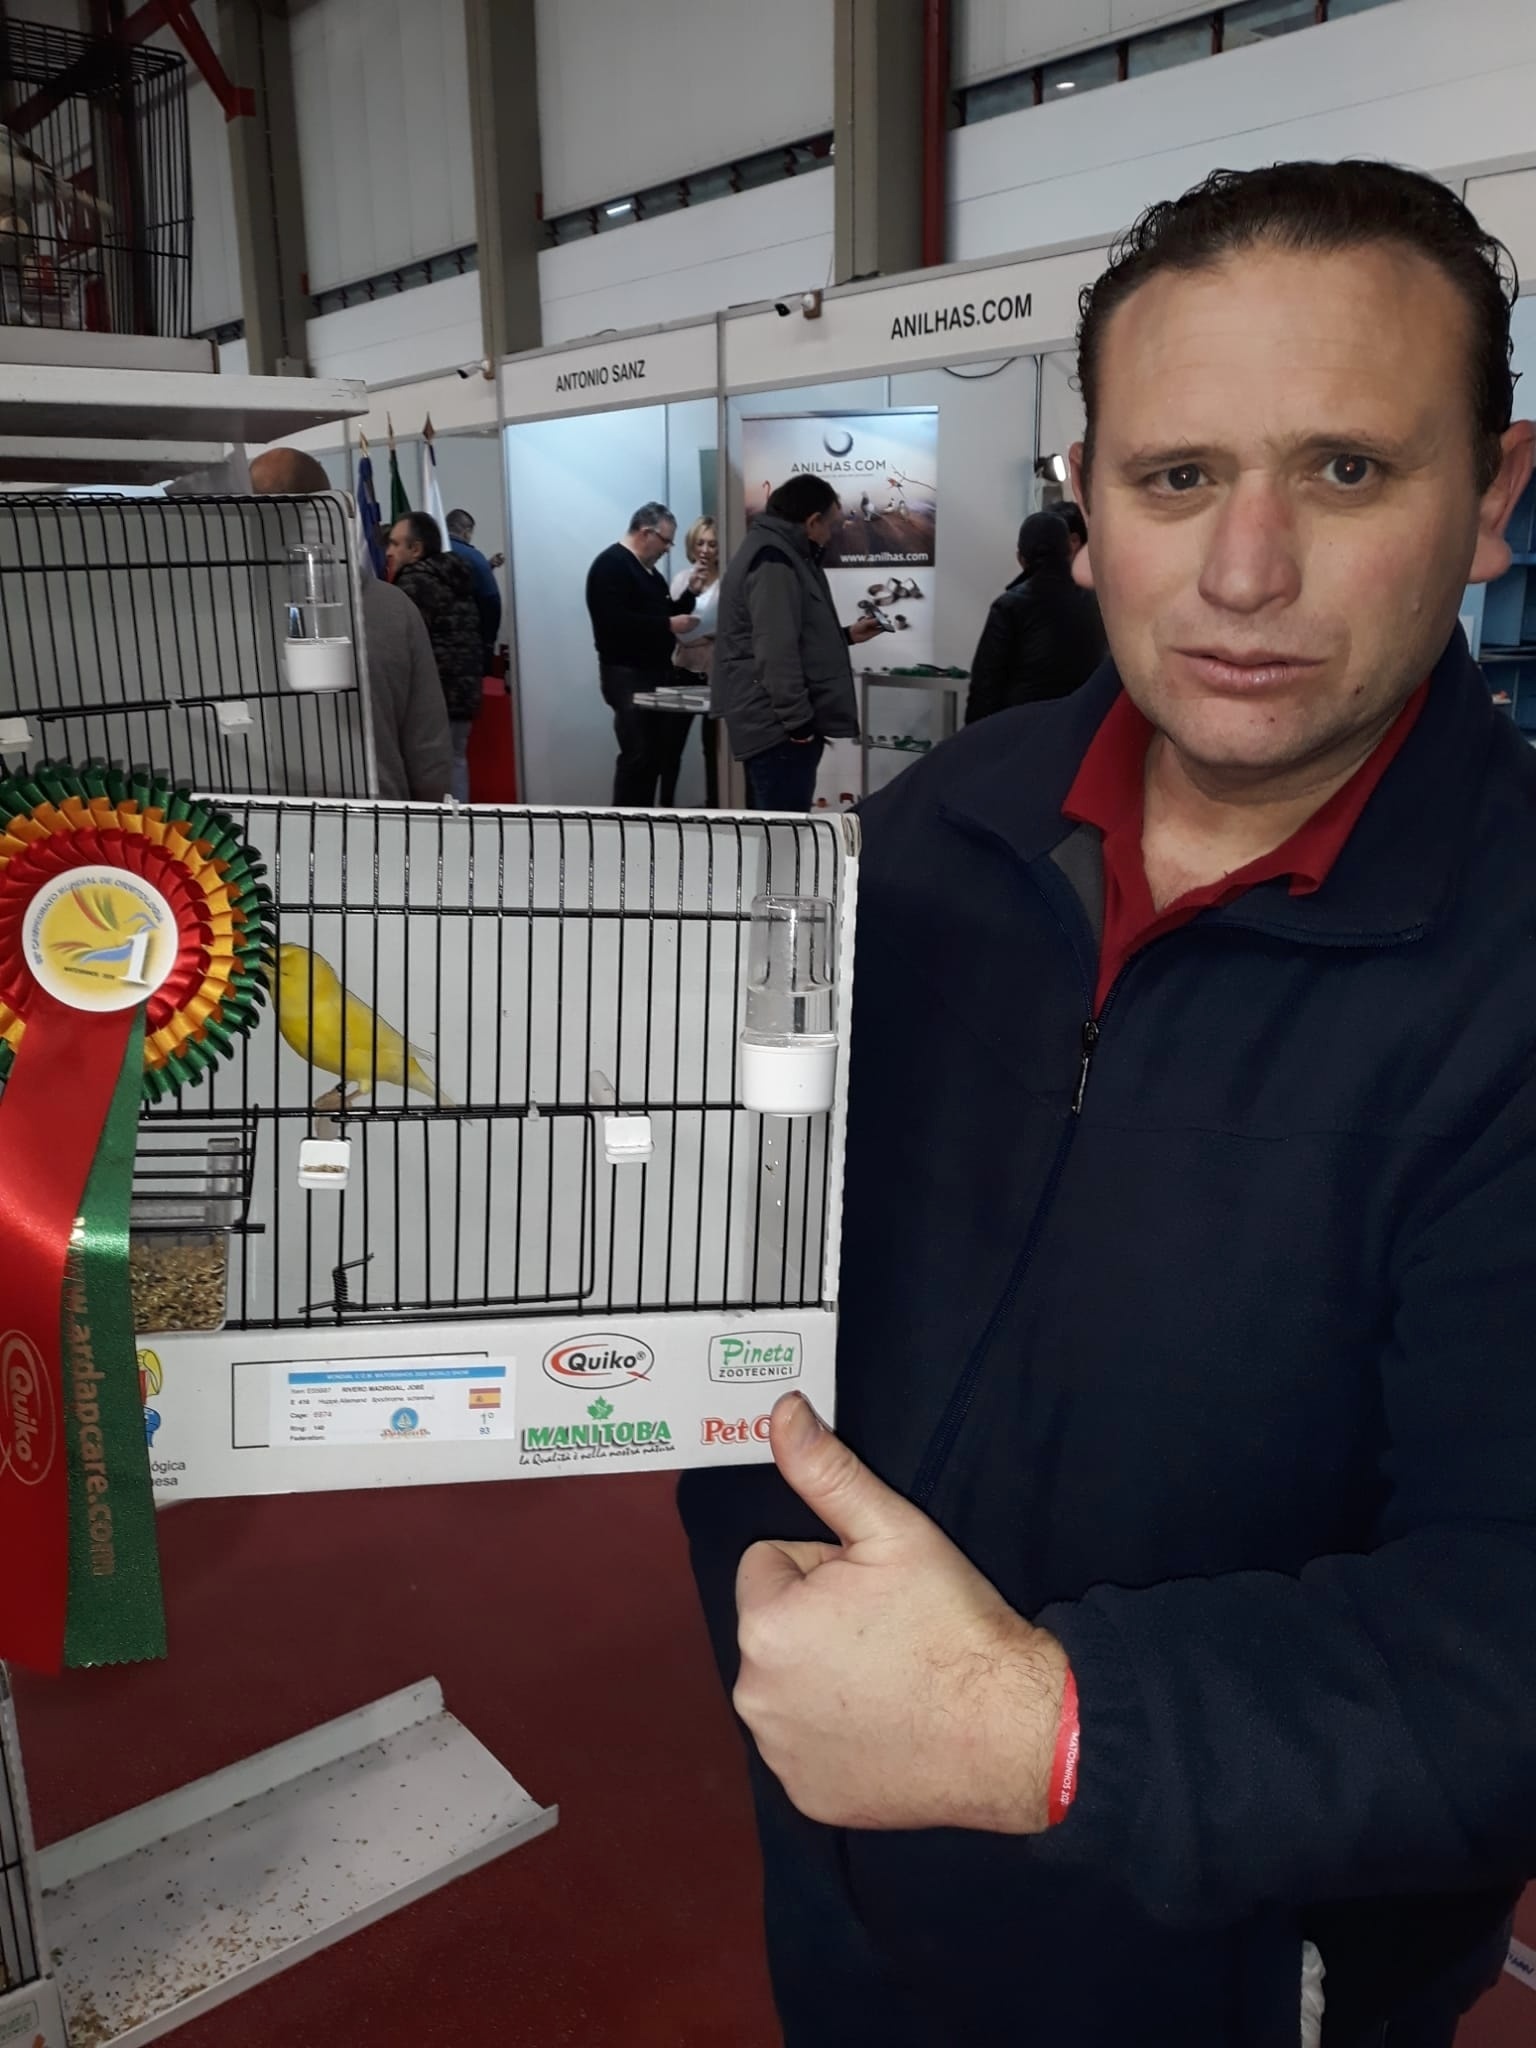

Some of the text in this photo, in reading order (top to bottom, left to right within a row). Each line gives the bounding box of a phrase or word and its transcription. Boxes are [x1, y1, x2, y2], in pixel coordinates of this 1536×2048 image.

[890, 293, 1032, 340] ANILHAS.COM
[556, 360, 645, 392] ANTONIO SANZ
[791, 460, 887, 473] ANILHAS.COM
[840, 551, 929, 563] www.anilhas.com
[99, 876, 112, 885] DE
[119, 931, 148, 985] 1
[719, 1338, 794, 1366] Pineta
[719, 1367, 793, 1378] ZOOTECNICI
[522, 1421, 672, 1452] MANITOBA
[702, 1417, 748, 1444] Pet
[150, 1460, 186, 1474] ógica
